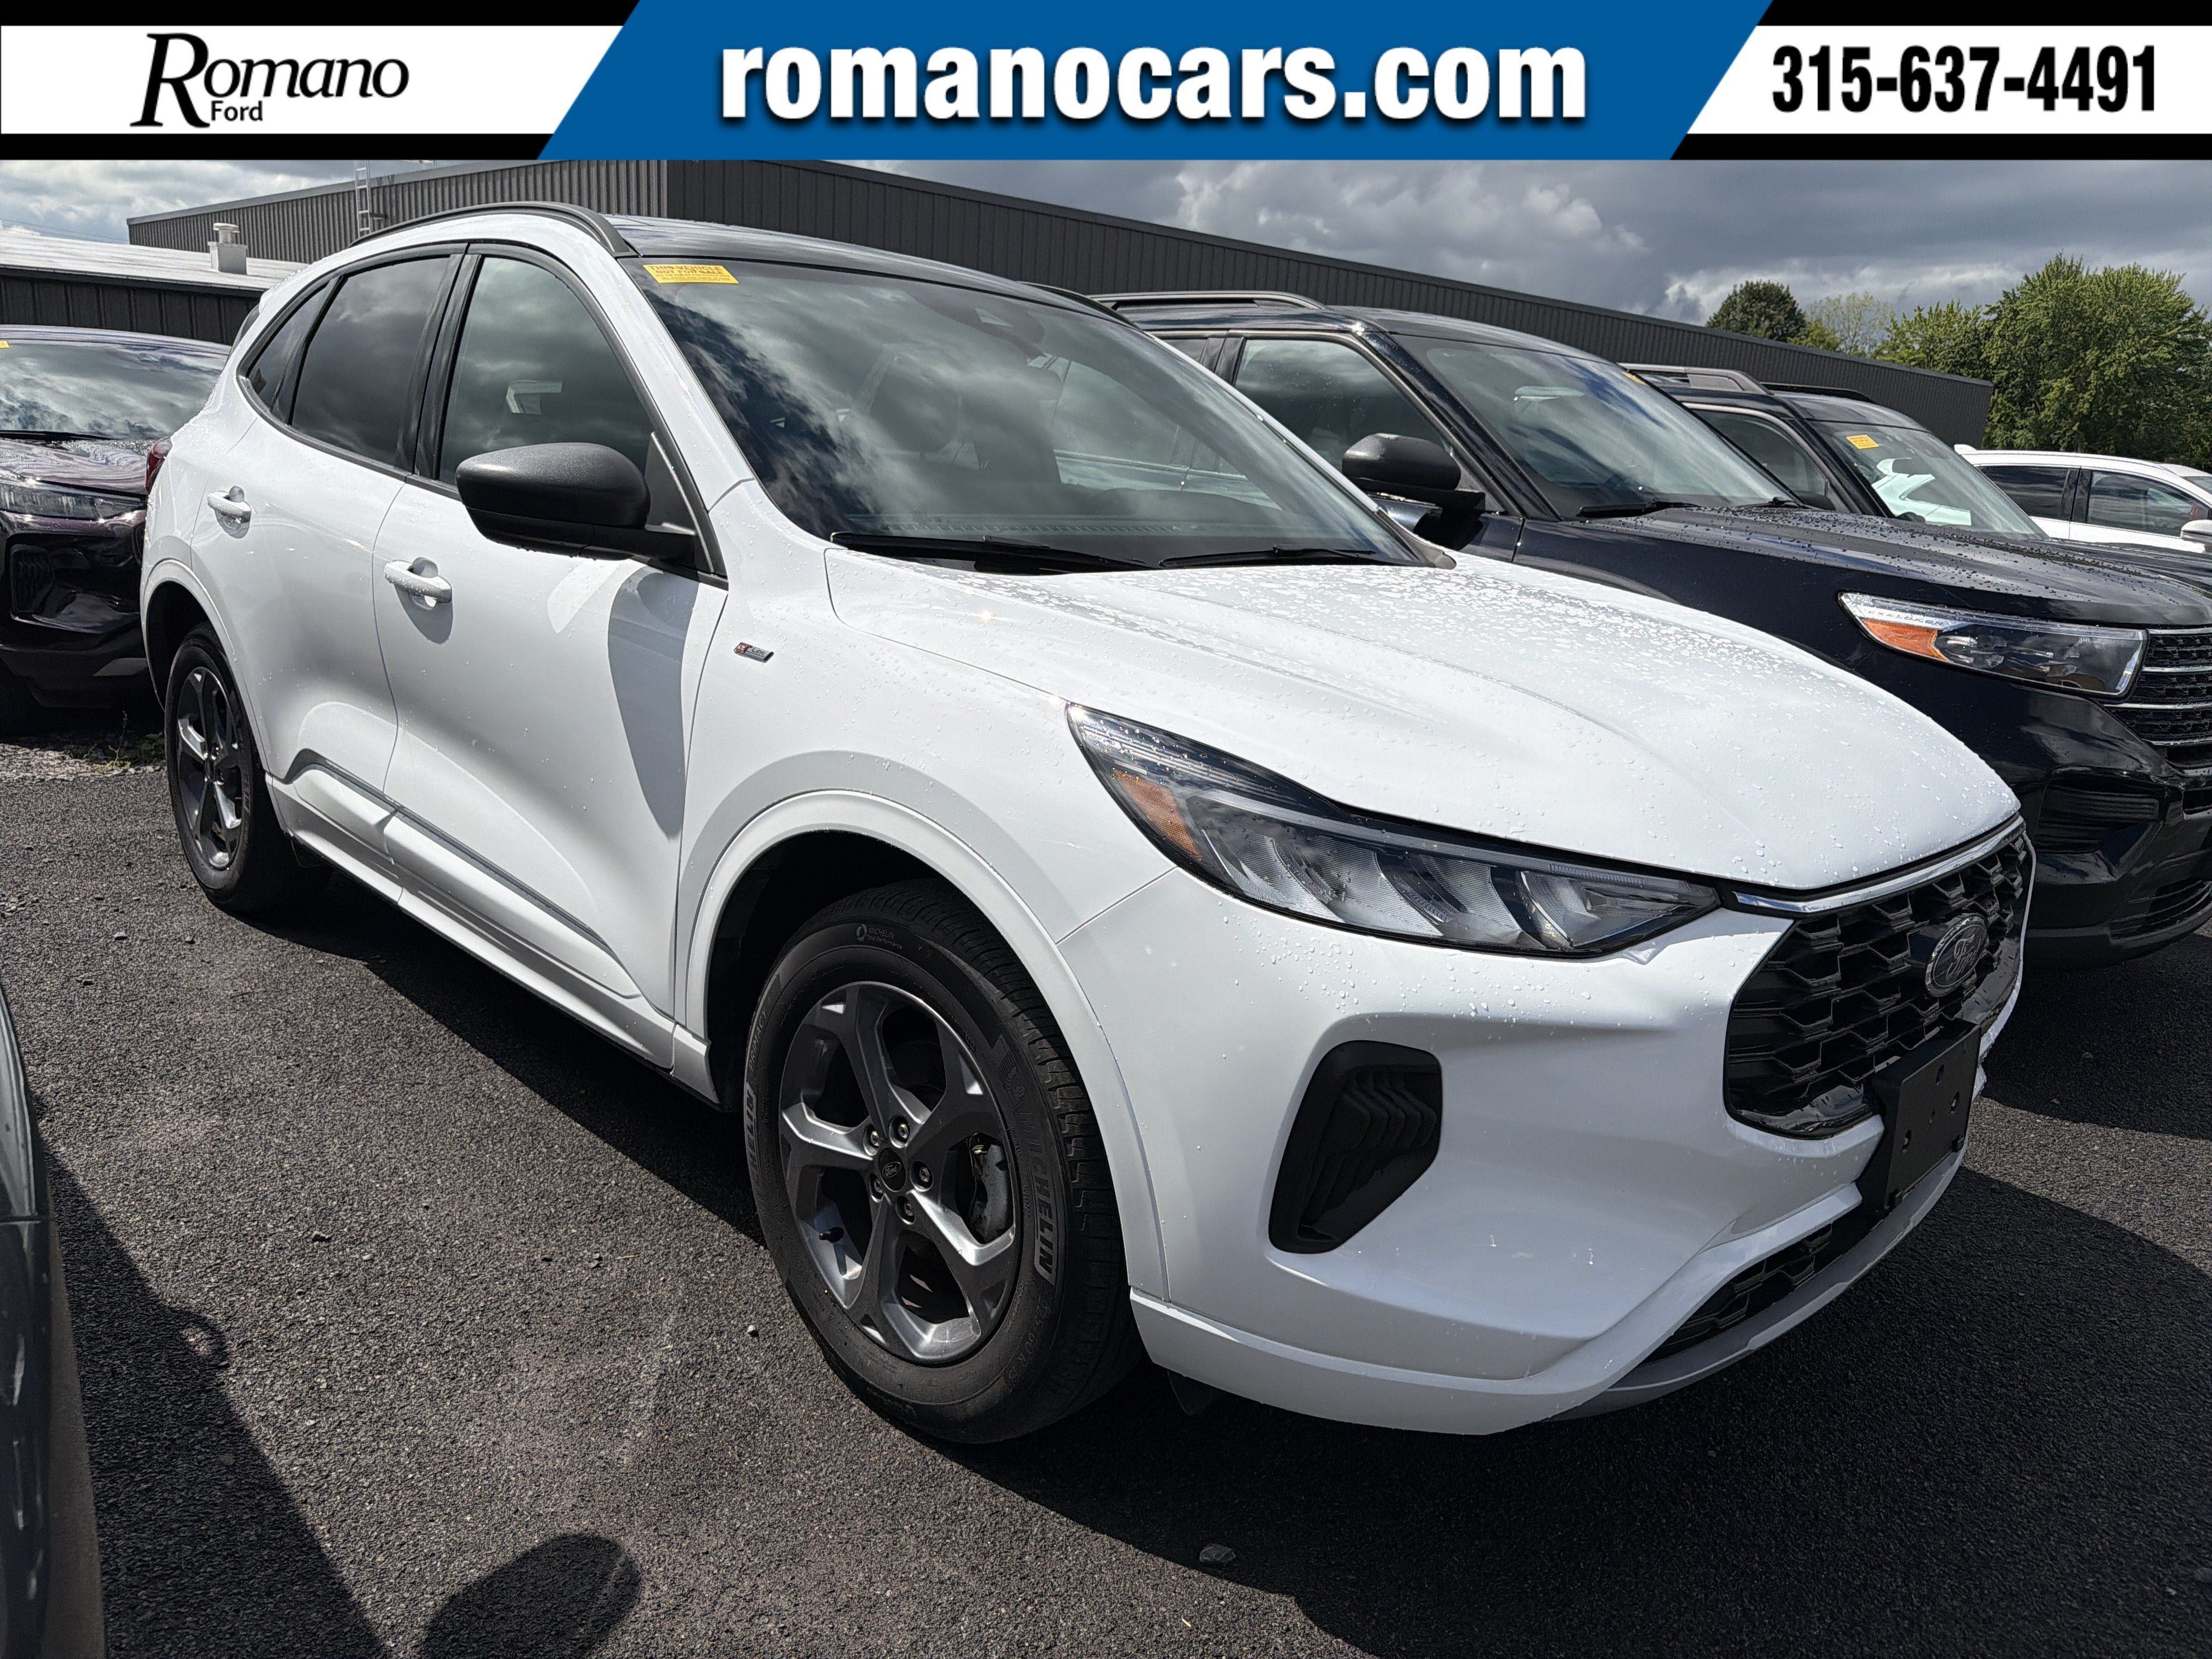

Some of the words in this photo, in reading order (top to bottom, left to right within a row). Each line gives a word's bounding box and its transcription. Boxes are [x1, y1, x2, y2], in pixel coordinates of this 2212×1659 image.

[868, 927, 896, 939] MICHELIN
[1946, 932, 1982, 981] Ford
[749, 1010, 766, 1072] PRIMACY
